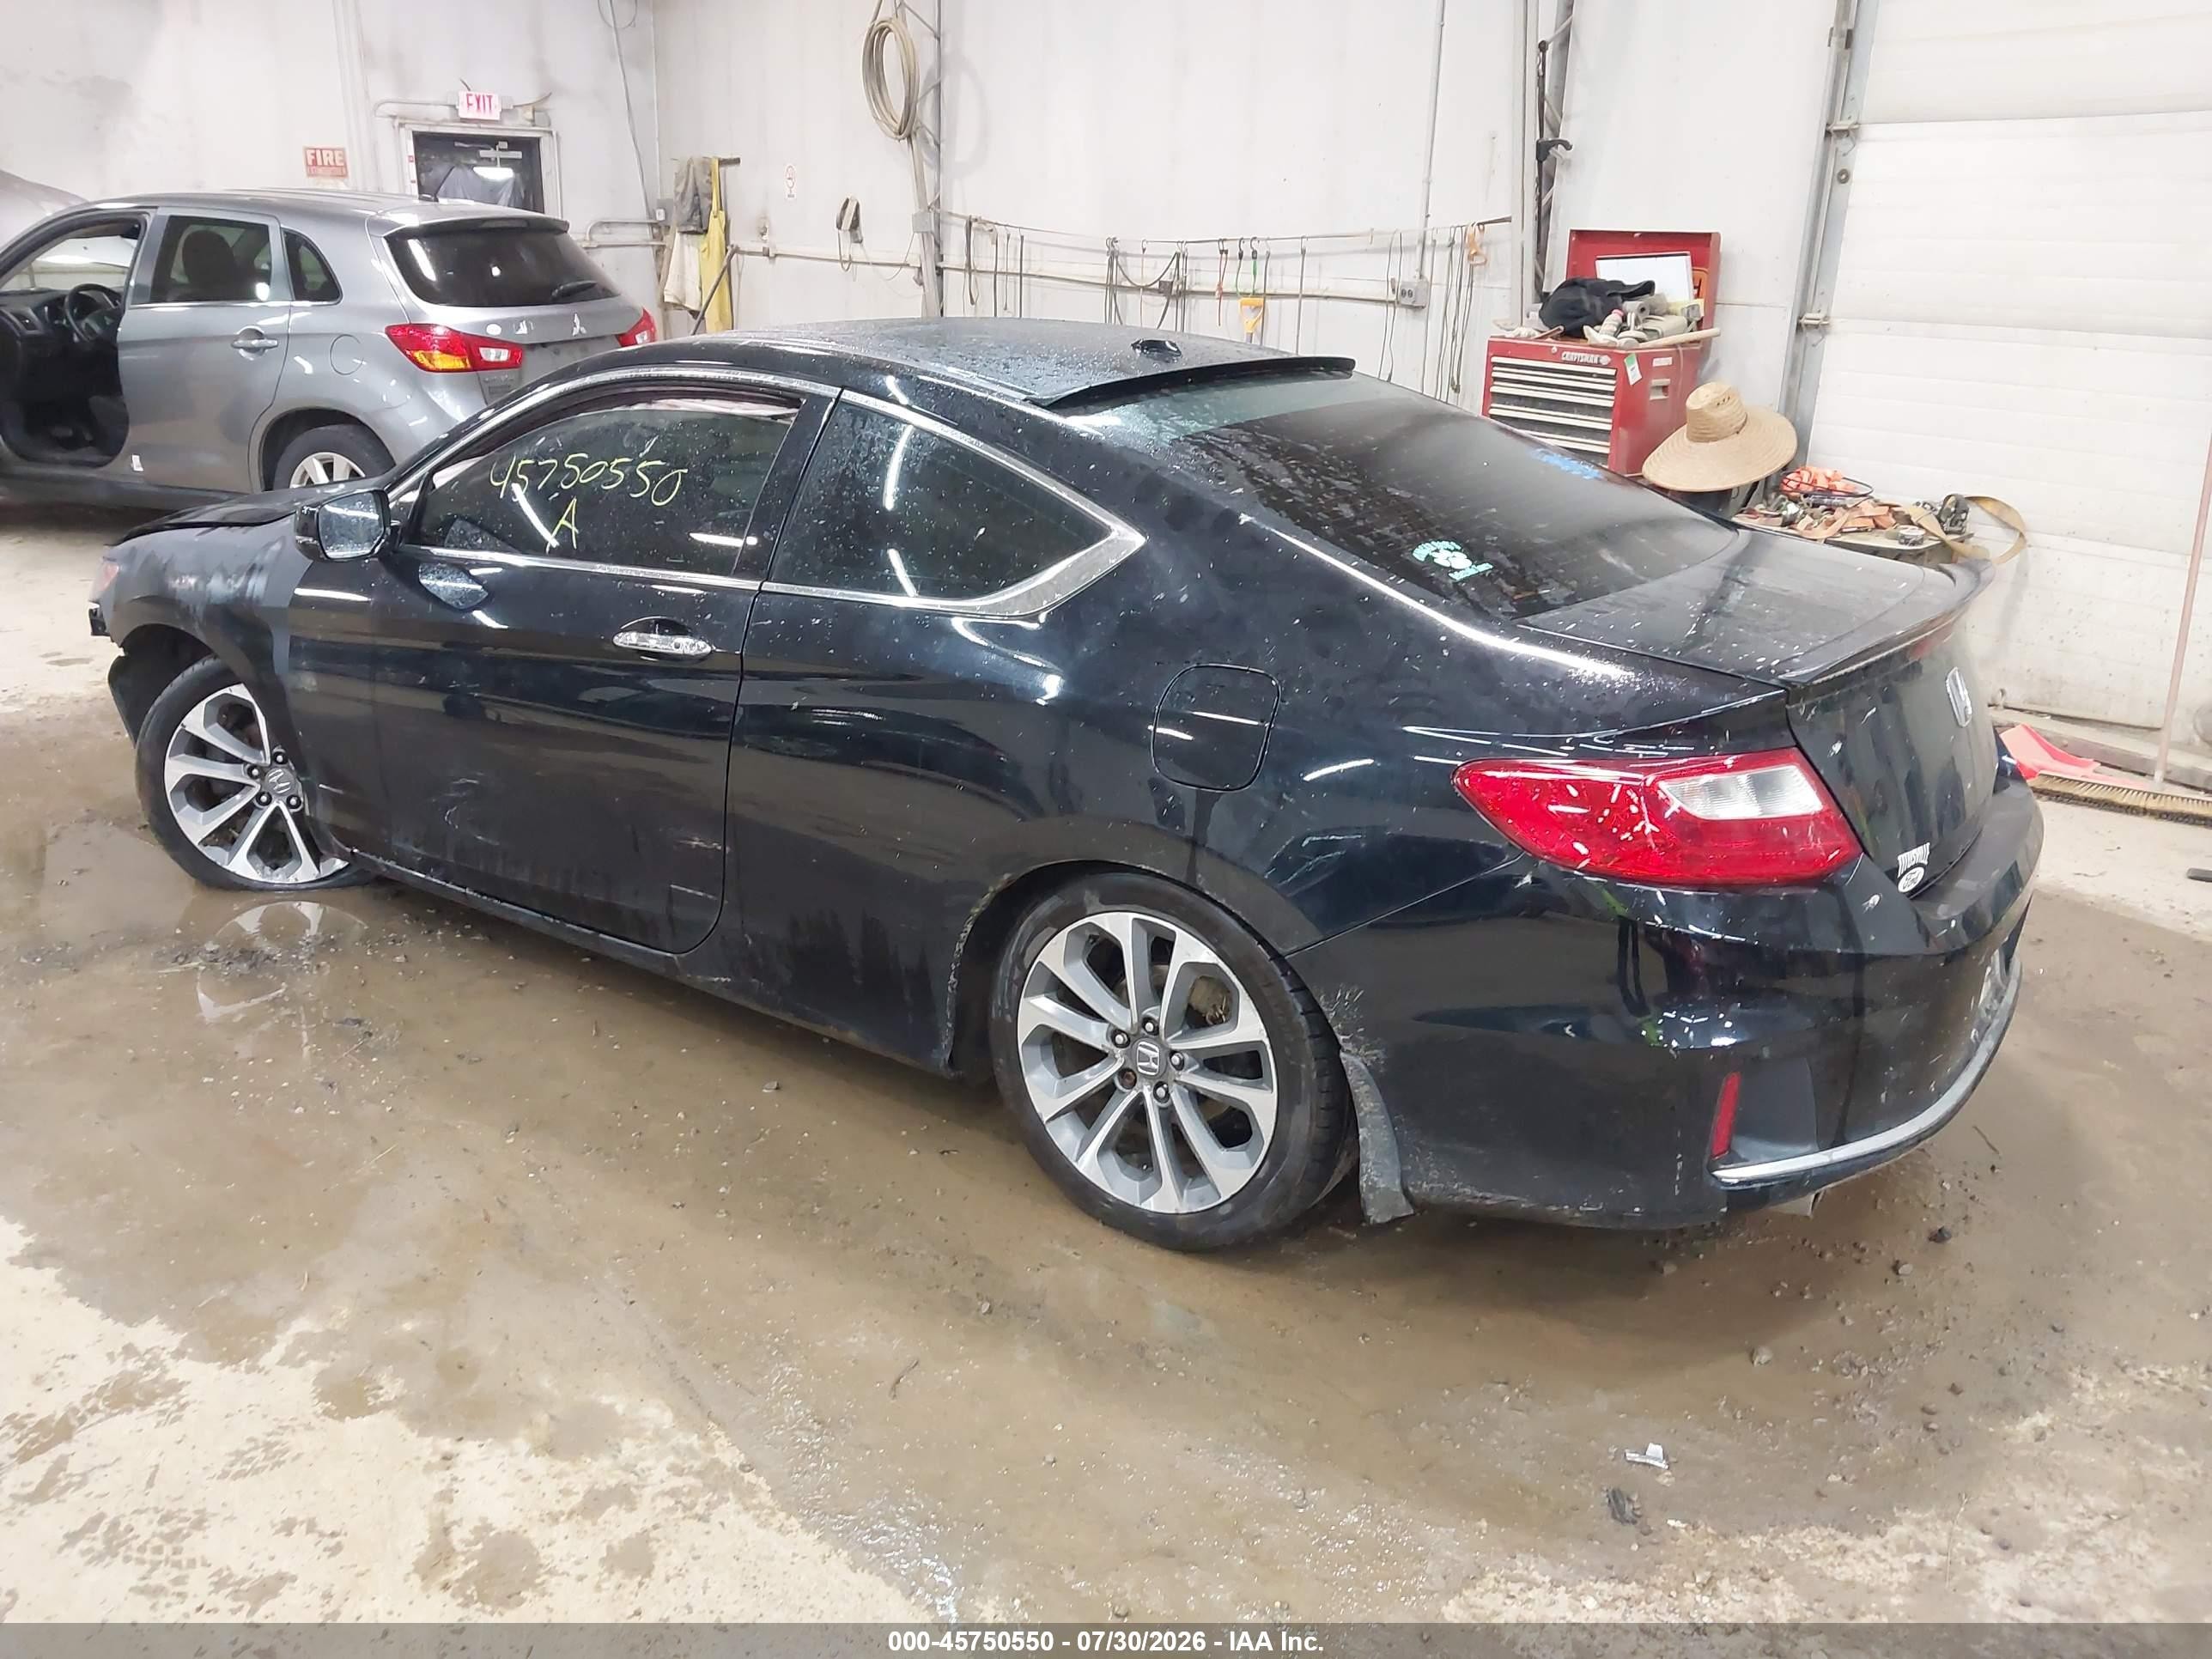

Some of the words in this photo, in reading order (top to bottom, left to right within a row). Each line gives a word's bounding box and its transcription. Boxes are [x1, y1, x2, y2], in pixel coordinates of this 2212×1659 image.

[466, 93, 493, 112] EXIT
[306, 149, 345, 167] FIRE
[489, 453, 689, 506] 45750550
[546, 495, 579, 555] A
